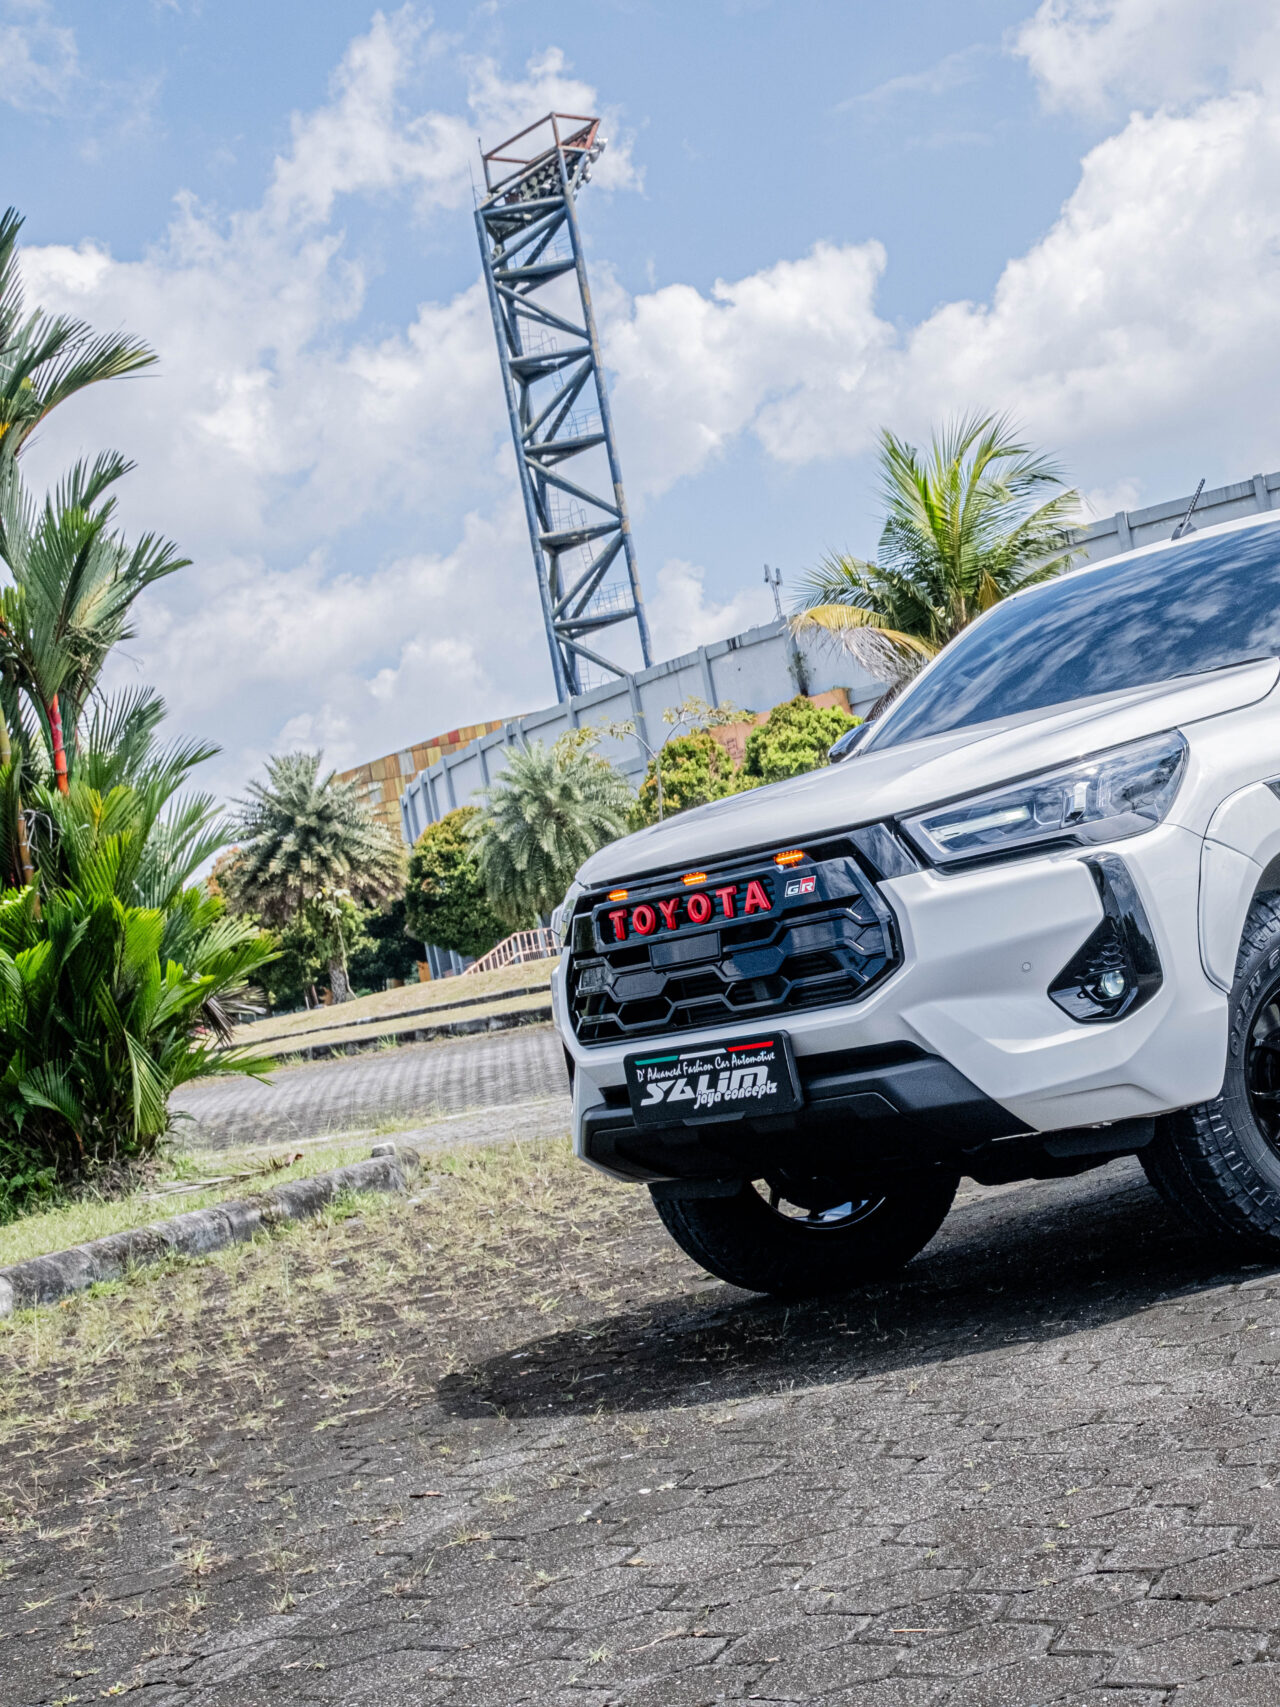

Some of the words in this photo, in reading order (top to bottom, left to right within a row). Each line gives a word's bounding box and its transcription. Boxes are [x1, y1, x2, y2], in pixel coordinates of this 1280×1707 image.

[787, 878, 815, 895] GR
[609, 880, 771, 941] TOYOTA
[647, 1066, 681, 1081] Advanced
[682, 1060, 714, 1075] Fashion
[715, 1056, 730, 1069] Car
[731, 1050, 775, 1067] Automotive
[693, 1090, 722, 1109] jaya
[724, 1080, 777, 1101] conceptz
